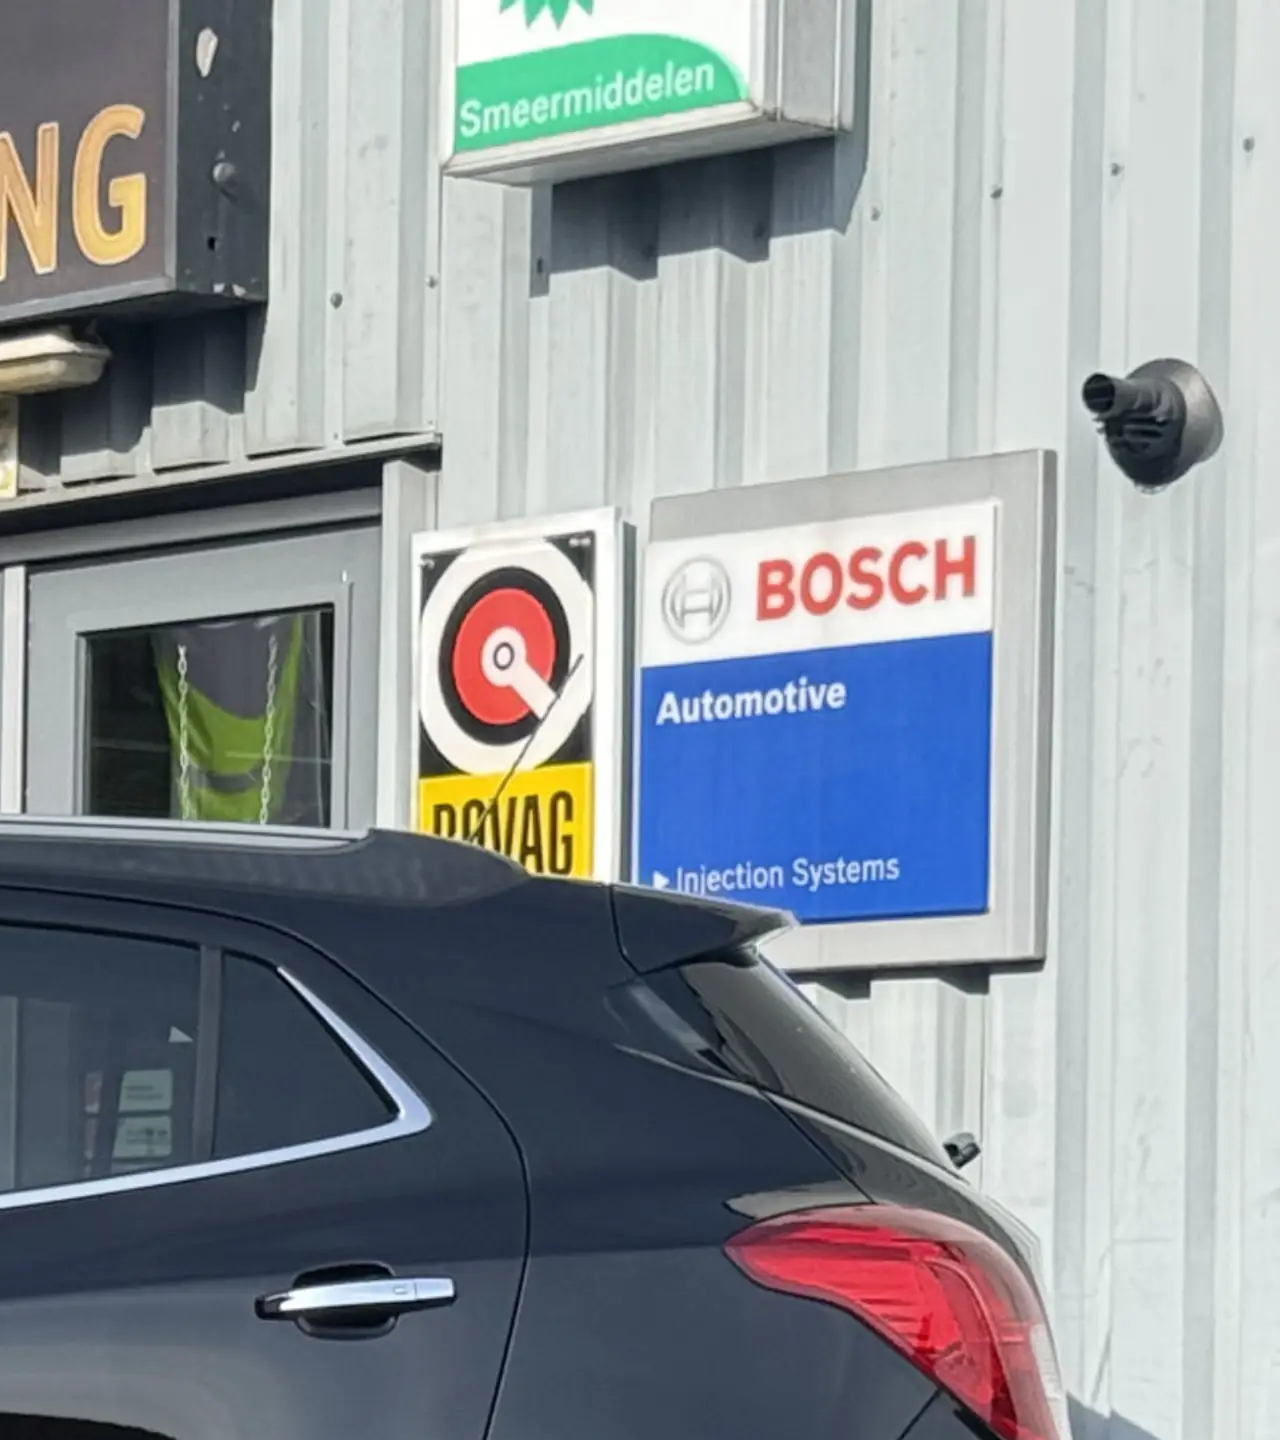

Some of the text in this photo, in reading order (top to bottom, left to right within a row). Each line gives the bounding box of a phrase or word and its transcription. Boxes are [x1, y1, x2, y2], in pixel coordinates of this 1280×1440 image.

[458, 60, 716, 138] Smeermiddelen
[756, 535, 977, 622] BOSCH
[655, 676, 847, 726] Automotive
[676, 856, 900, 896] Injection Systems
